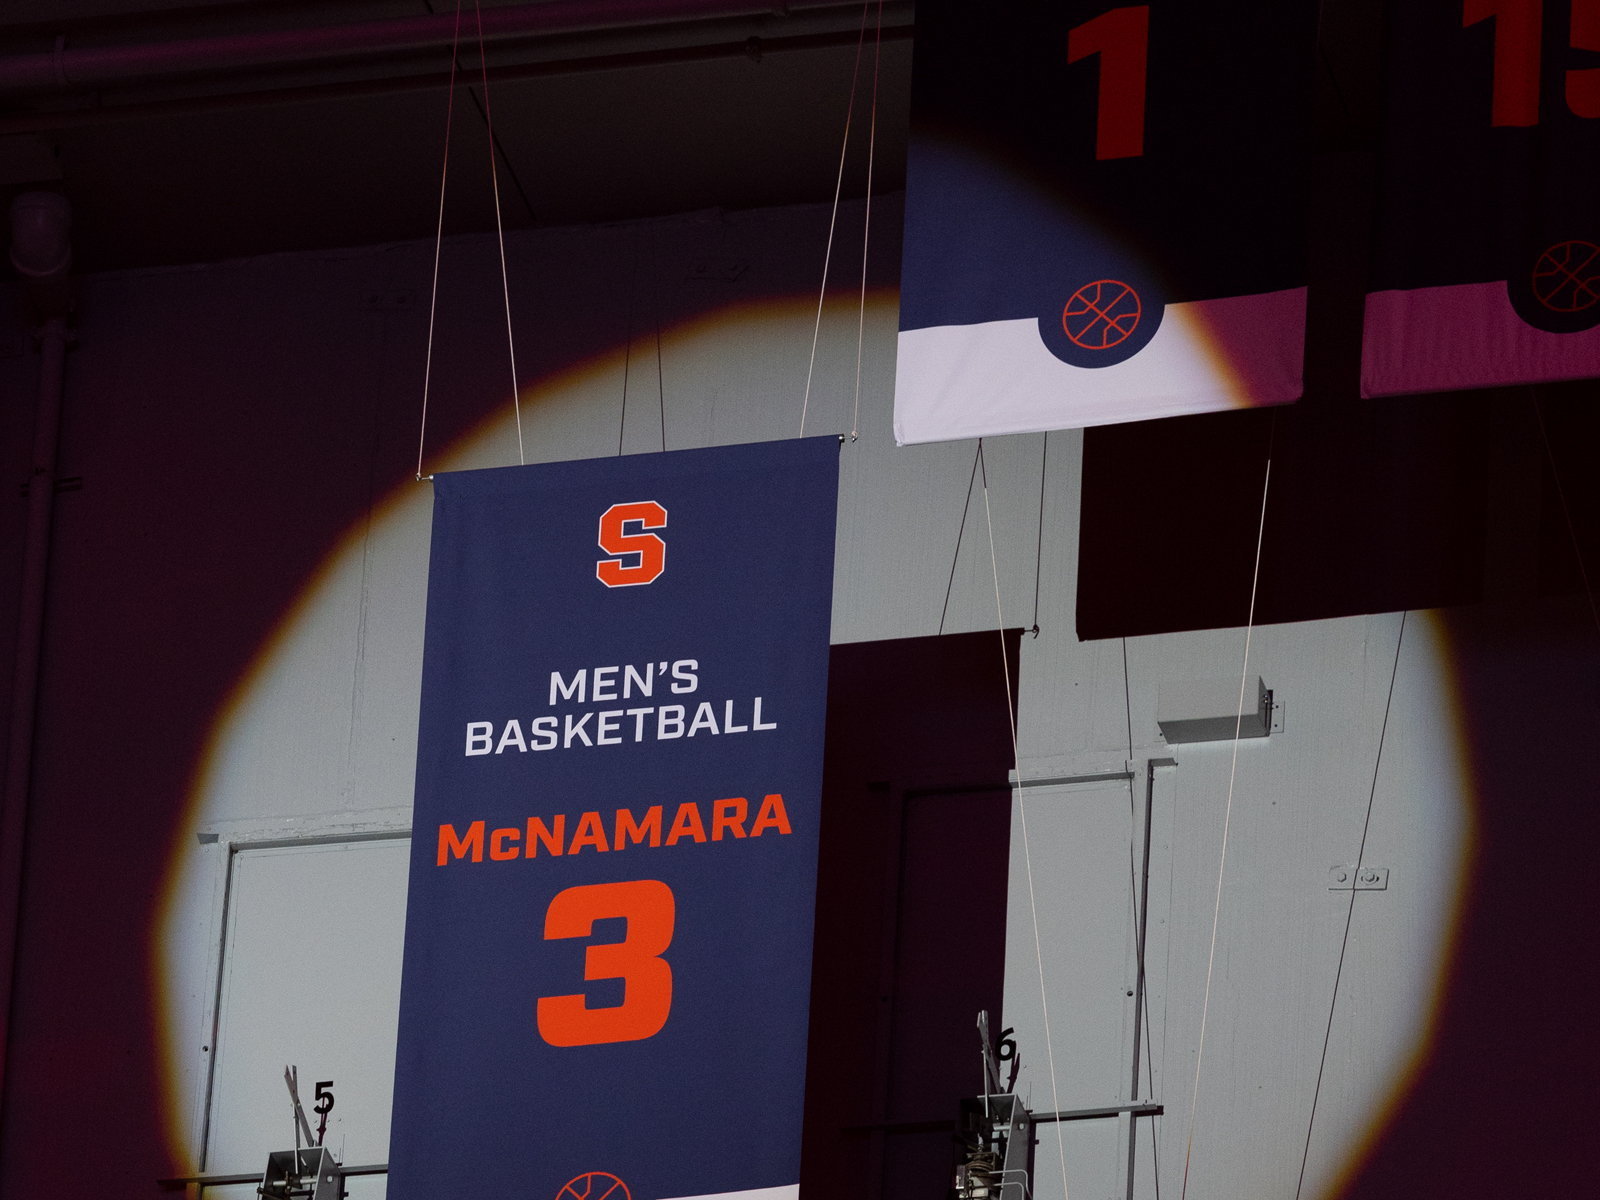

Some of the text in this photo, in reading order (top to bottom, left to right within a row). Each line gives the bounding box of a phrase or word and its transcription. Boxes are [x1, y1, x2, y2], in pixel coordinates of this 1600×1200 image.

[1066, 4, 1150, 161] 1
[596, 500, 668, 588] S
[549, 659, 699, 706] MEN'S
[465, 697, 778, 757] BASKETBALL
[436, 793, 793, 867] McNAMARA
[536, 879, 676, 1048] 3
[995, 1027, 1016, 1061] 6
[313, 1081, 335, 1115] 5
